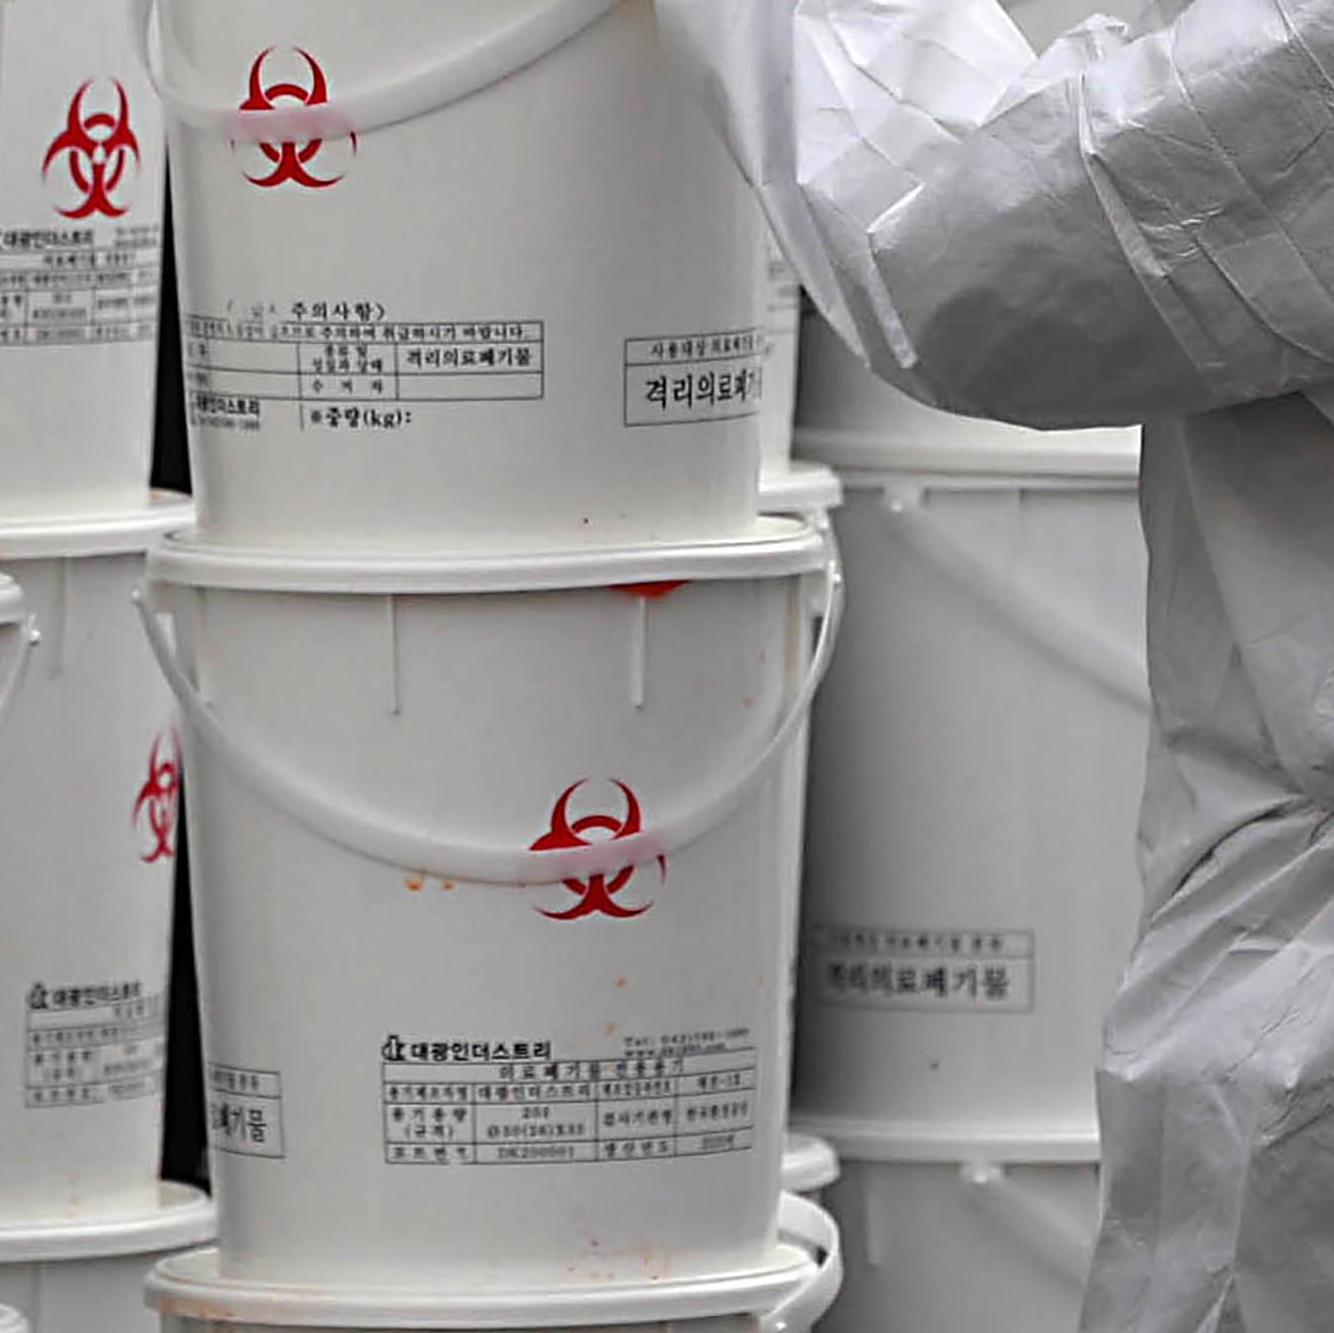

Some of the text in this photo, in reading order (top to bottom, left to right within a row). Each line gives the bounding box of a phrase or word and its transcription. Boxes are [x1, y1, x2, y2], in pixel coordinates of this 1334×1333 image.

[408, 348, 531, 368] 격리의료폐기물
[651, 341, 706, 358] 사용대상
[411, 1041, 551, 1061] 대광인더스트리
